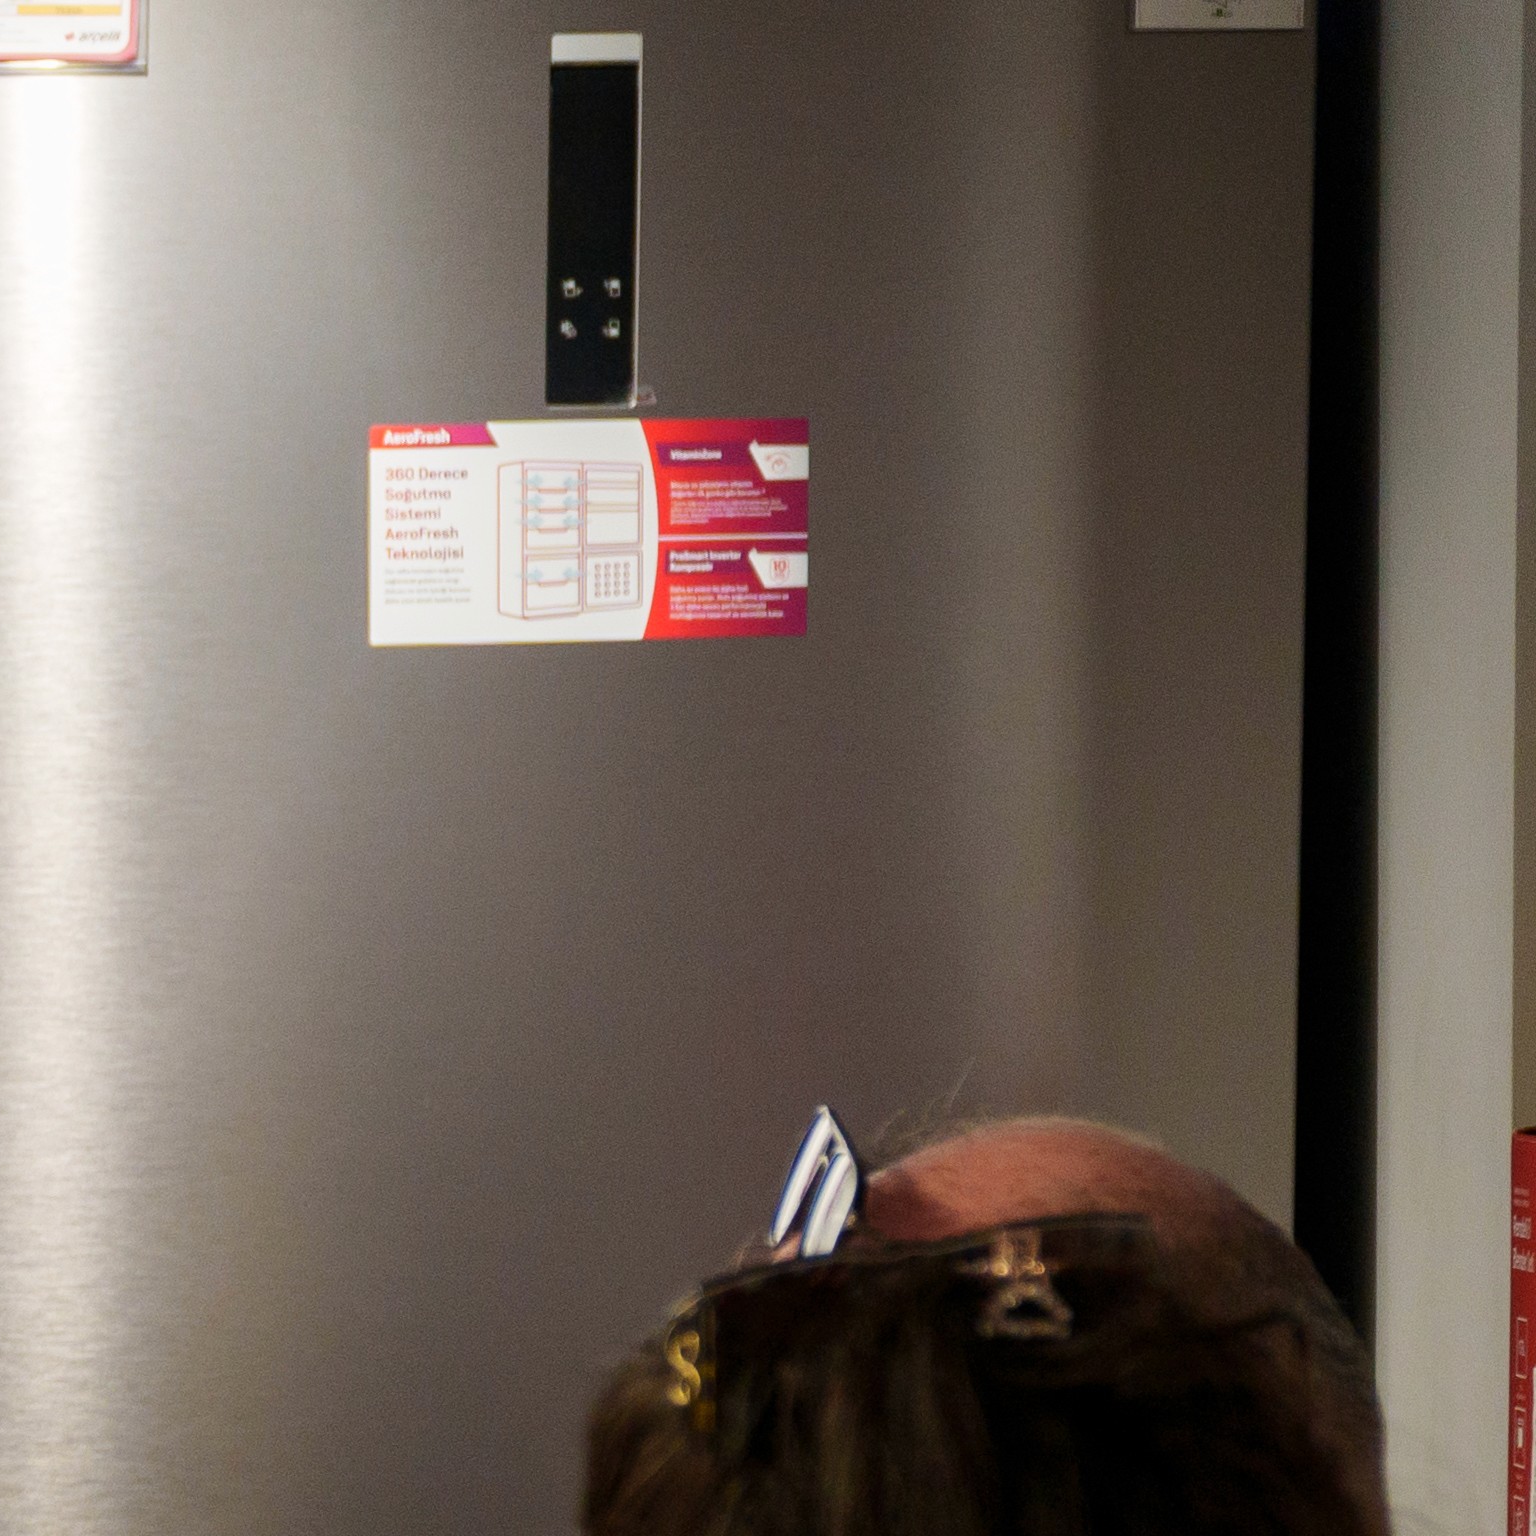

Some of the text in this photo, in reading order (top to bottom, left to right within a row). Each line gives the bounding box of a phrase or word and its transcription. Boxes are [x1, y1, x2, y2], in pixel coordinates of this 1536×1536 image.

[383, 427, 451, 446] AeroFresh
[385, 466, 469, 481] 360 Derece
[385, 487, 452, 504] Soğutma
[385, 506, 441, 521] Sistemi
[385, 525, 459, 540] AeroFresh
[385, 546, 464, 563] Teknolojisi
